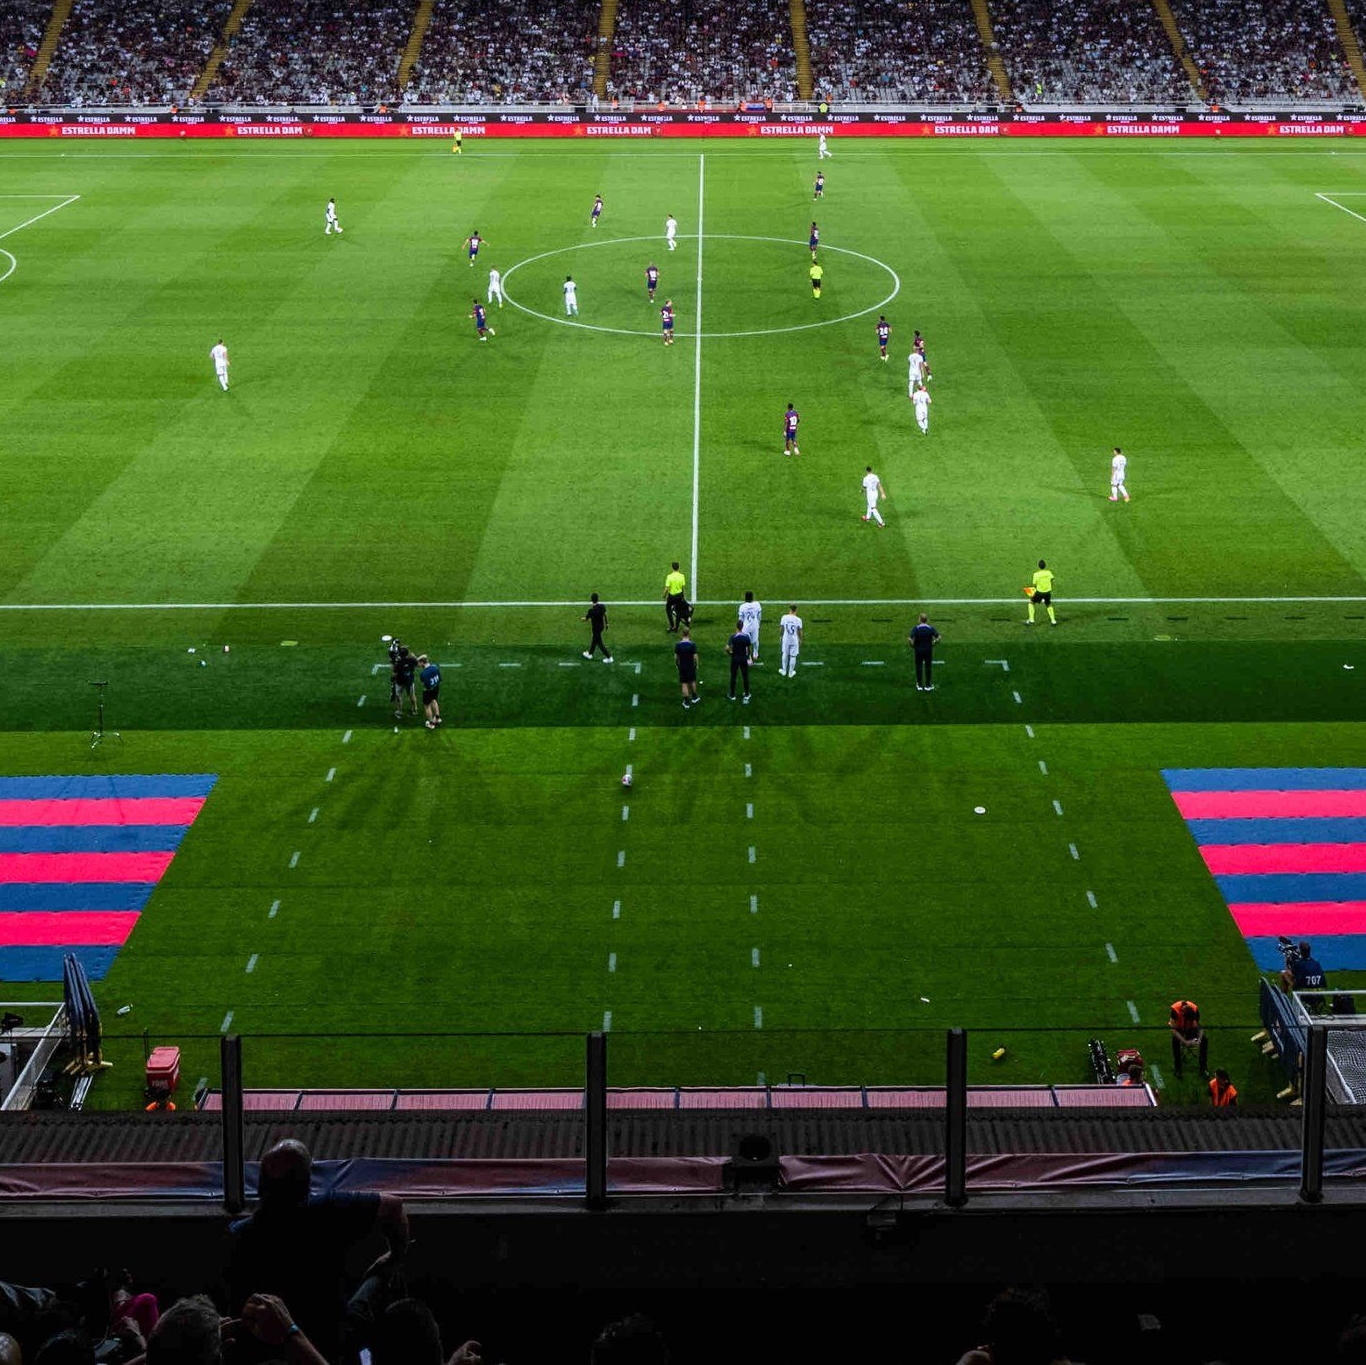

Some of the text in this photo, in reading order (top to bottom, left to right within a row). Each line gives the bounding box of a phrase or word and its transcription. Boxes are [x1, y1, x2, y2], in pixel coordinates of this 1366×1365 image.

[62, 126, 135, 135] ESTRELLA DAMM
[237, 126, 280, 135] ESTRELLA
[412, 126, 454, 135] ESTRELLA
[587, 126, 629, 135] ESTRELLA
[761, 126, 833, 135] ESTRELLA DAMM
[934, 125, 976, 134] ESTRELLA
[1107, 125, 1179, 134] ESTRELLA DAMM
[1280, 125, 1322, 134] ESTRELLA
